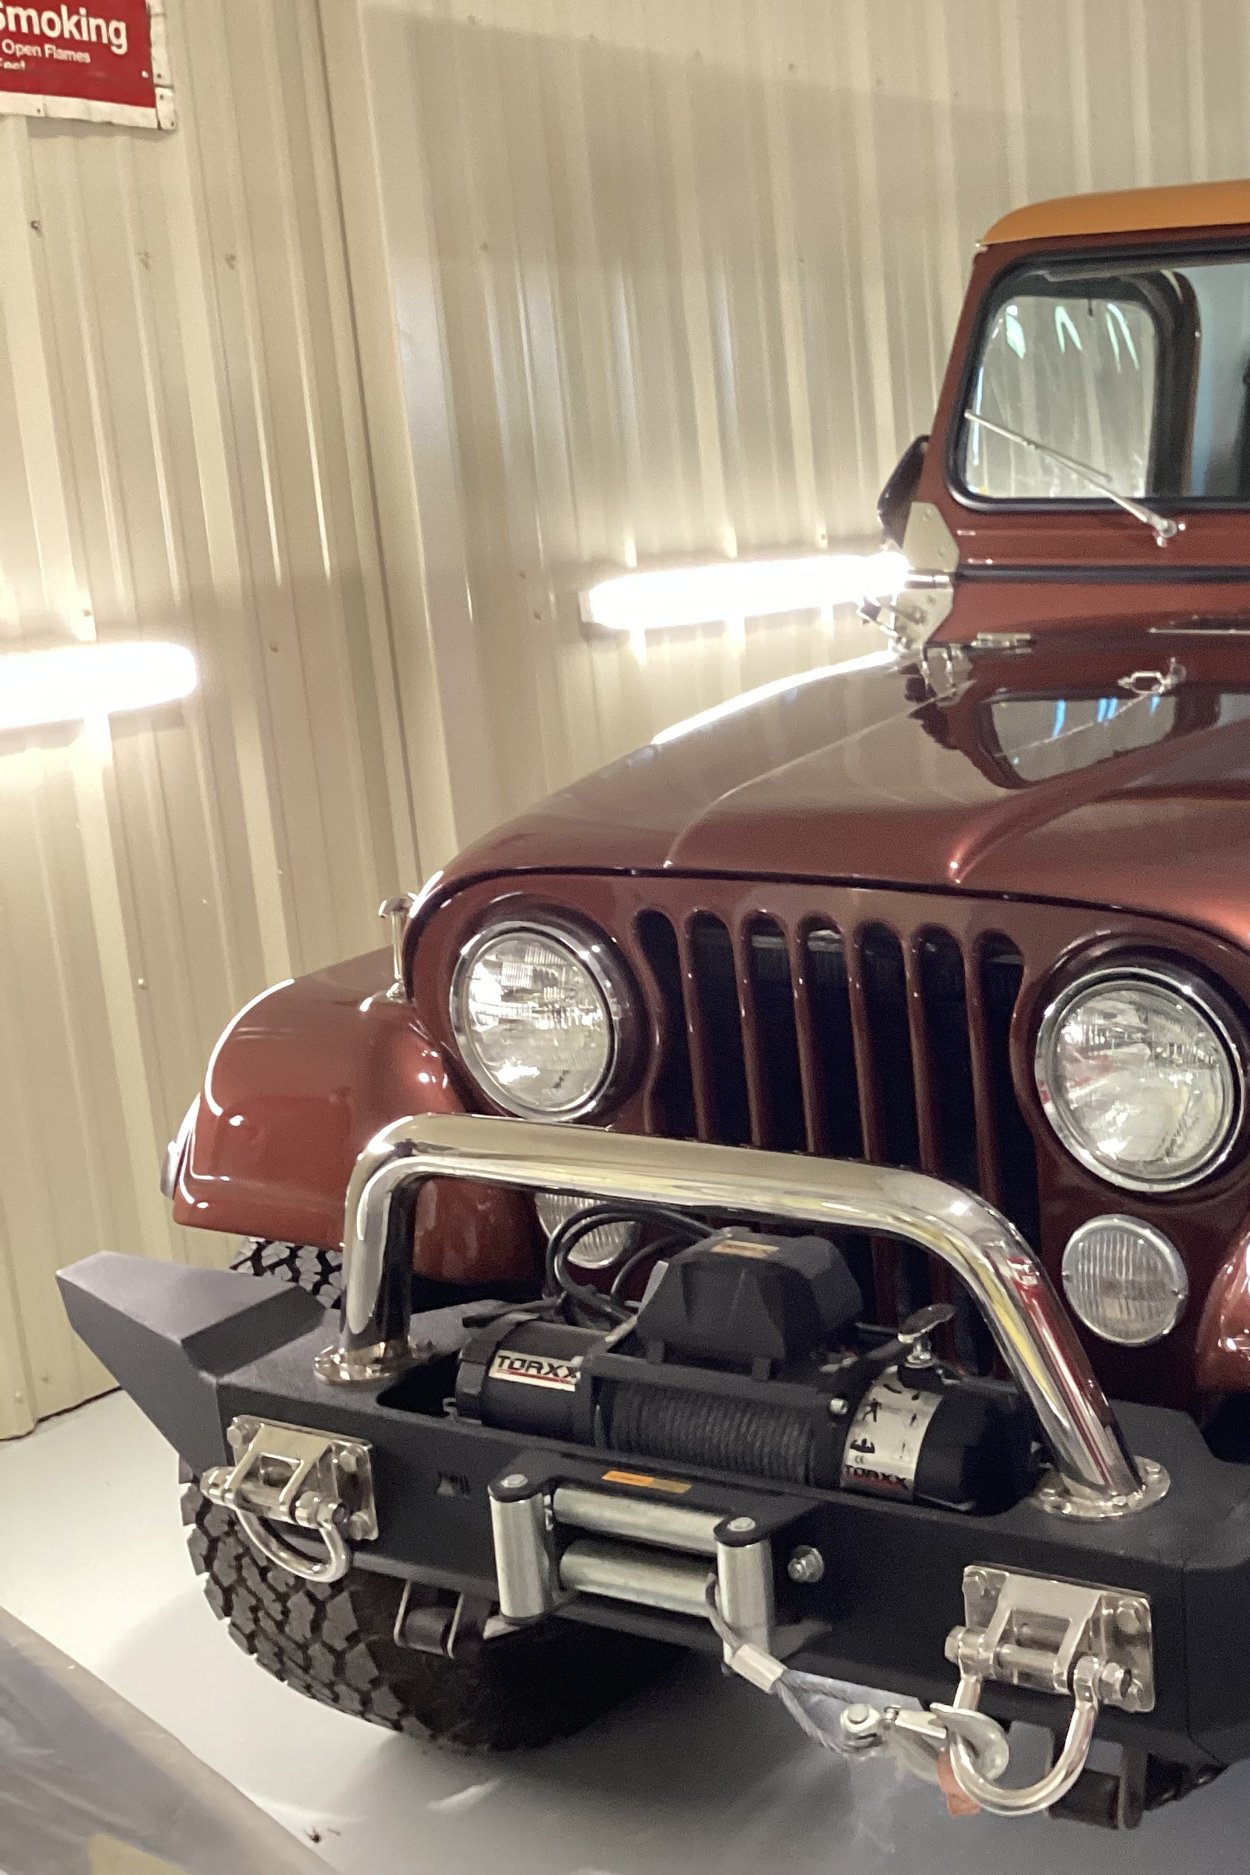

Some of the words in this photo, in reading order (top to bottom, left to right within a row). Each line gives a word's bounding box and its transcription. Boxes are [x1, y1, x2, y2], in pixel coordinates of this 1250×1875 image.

[1, 39, 42, 58] Open
[44, 44, 91, 63] Flames
[498, 1355, 579, 1379] TORXX
